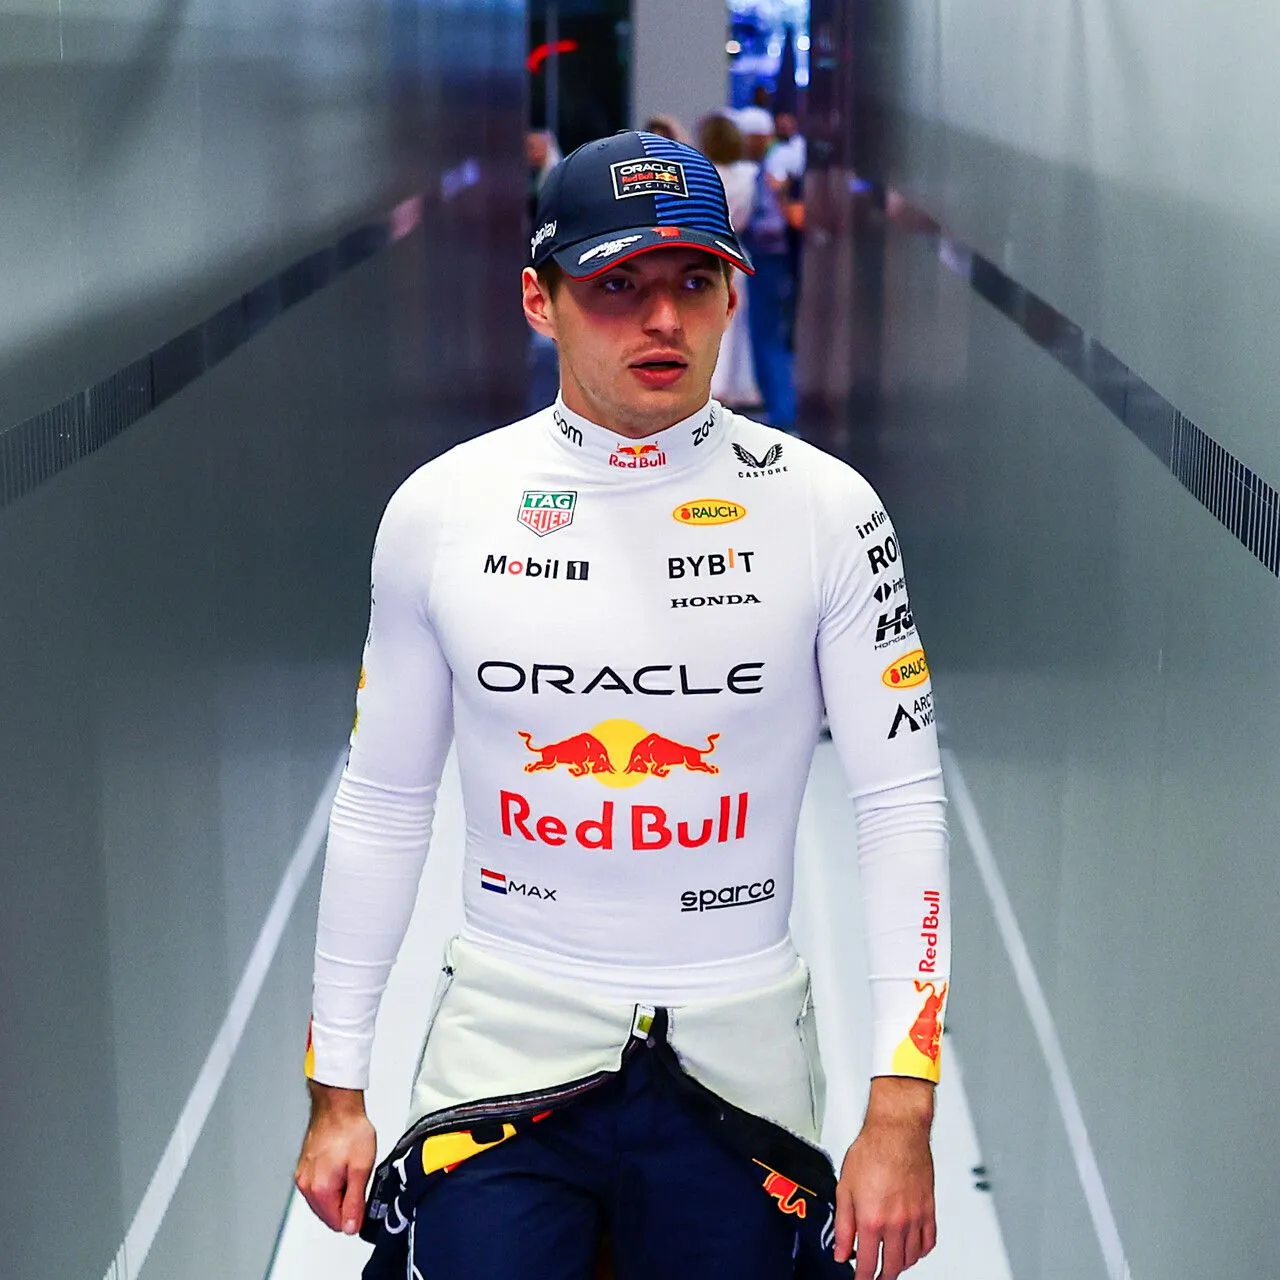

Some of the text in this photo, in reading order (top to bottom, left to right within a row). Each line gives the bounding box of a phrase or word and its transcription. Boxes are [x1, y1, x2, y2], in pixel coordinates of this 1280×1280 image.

[620, 163, 677, 176] ORACLE
[622, 174, 637, 183] Red
[623, 182, 680, 192] RACING
[609, 452, 666, 469] Red Bull
[738, 466, 789, 478] CASTORE
[529, 494, 571, 508] TAG
[521, 510, 570, 533] HEUER
[692, 506, 738, 519] RAUCH
[484, 554, 559, 579] Mobil
[668, 548, 754, 579] BYBIT
[670, 593, 761, 609] HONDA
[477, 661, 767, 696] ORACLE
[900, 657, 927, 680] RAUC
[500, 790, 748, 850] Red Bull
[508, 880, 557, 901] MAX
[681, 878, 775, 911] sparco
[919, 890, 940, 973] Red Bull
